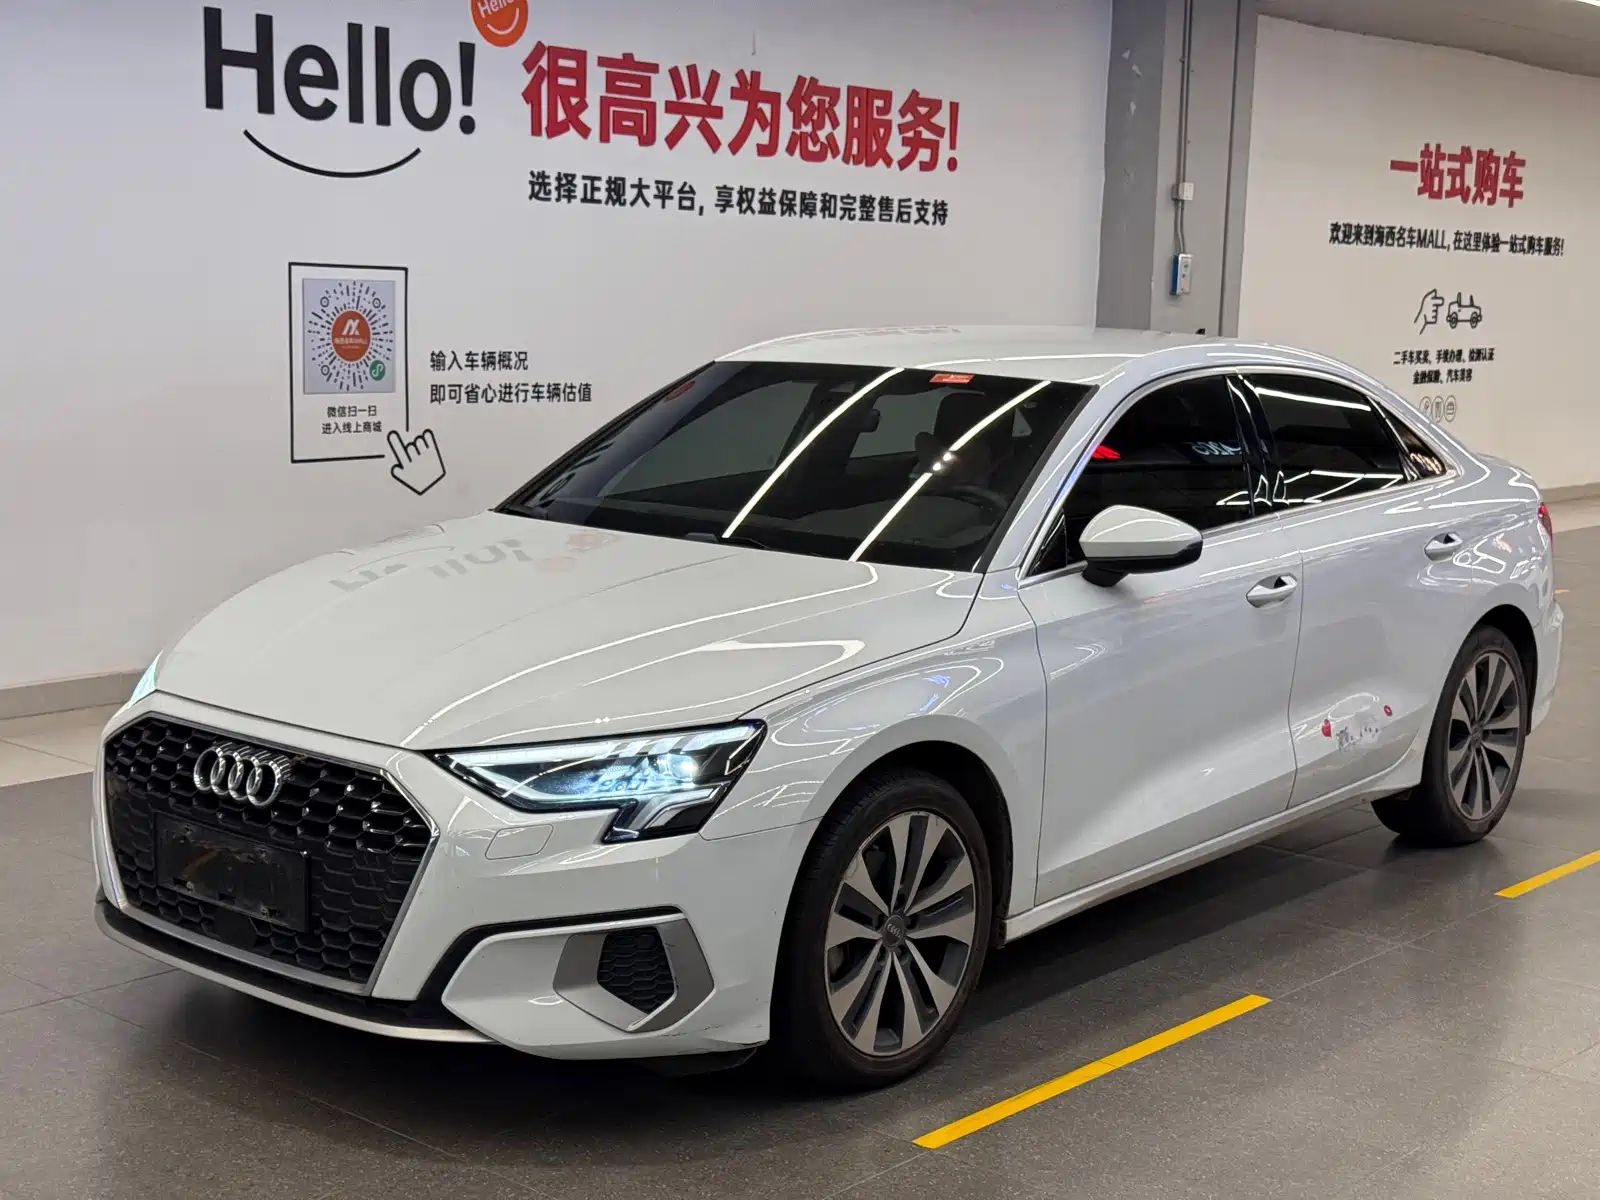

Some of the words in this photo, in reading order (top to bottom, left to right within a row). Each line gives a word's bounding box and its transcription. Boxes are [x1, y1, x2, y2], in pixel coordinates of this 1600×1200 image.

[203, 7, 476, 135] Hello!
[521, 40, 960, 173] 很高兴为您服务!
[1390, 143, 1527, 208] 一站式购车
[429, 350, 529, 372] 输入车辆概况
[429, 382, 593, 405] 即可省心进行车辆估值
[327, 405, 377, 418] 微信扫一扫
[321, 421, 383, 434] 进入线上商城
